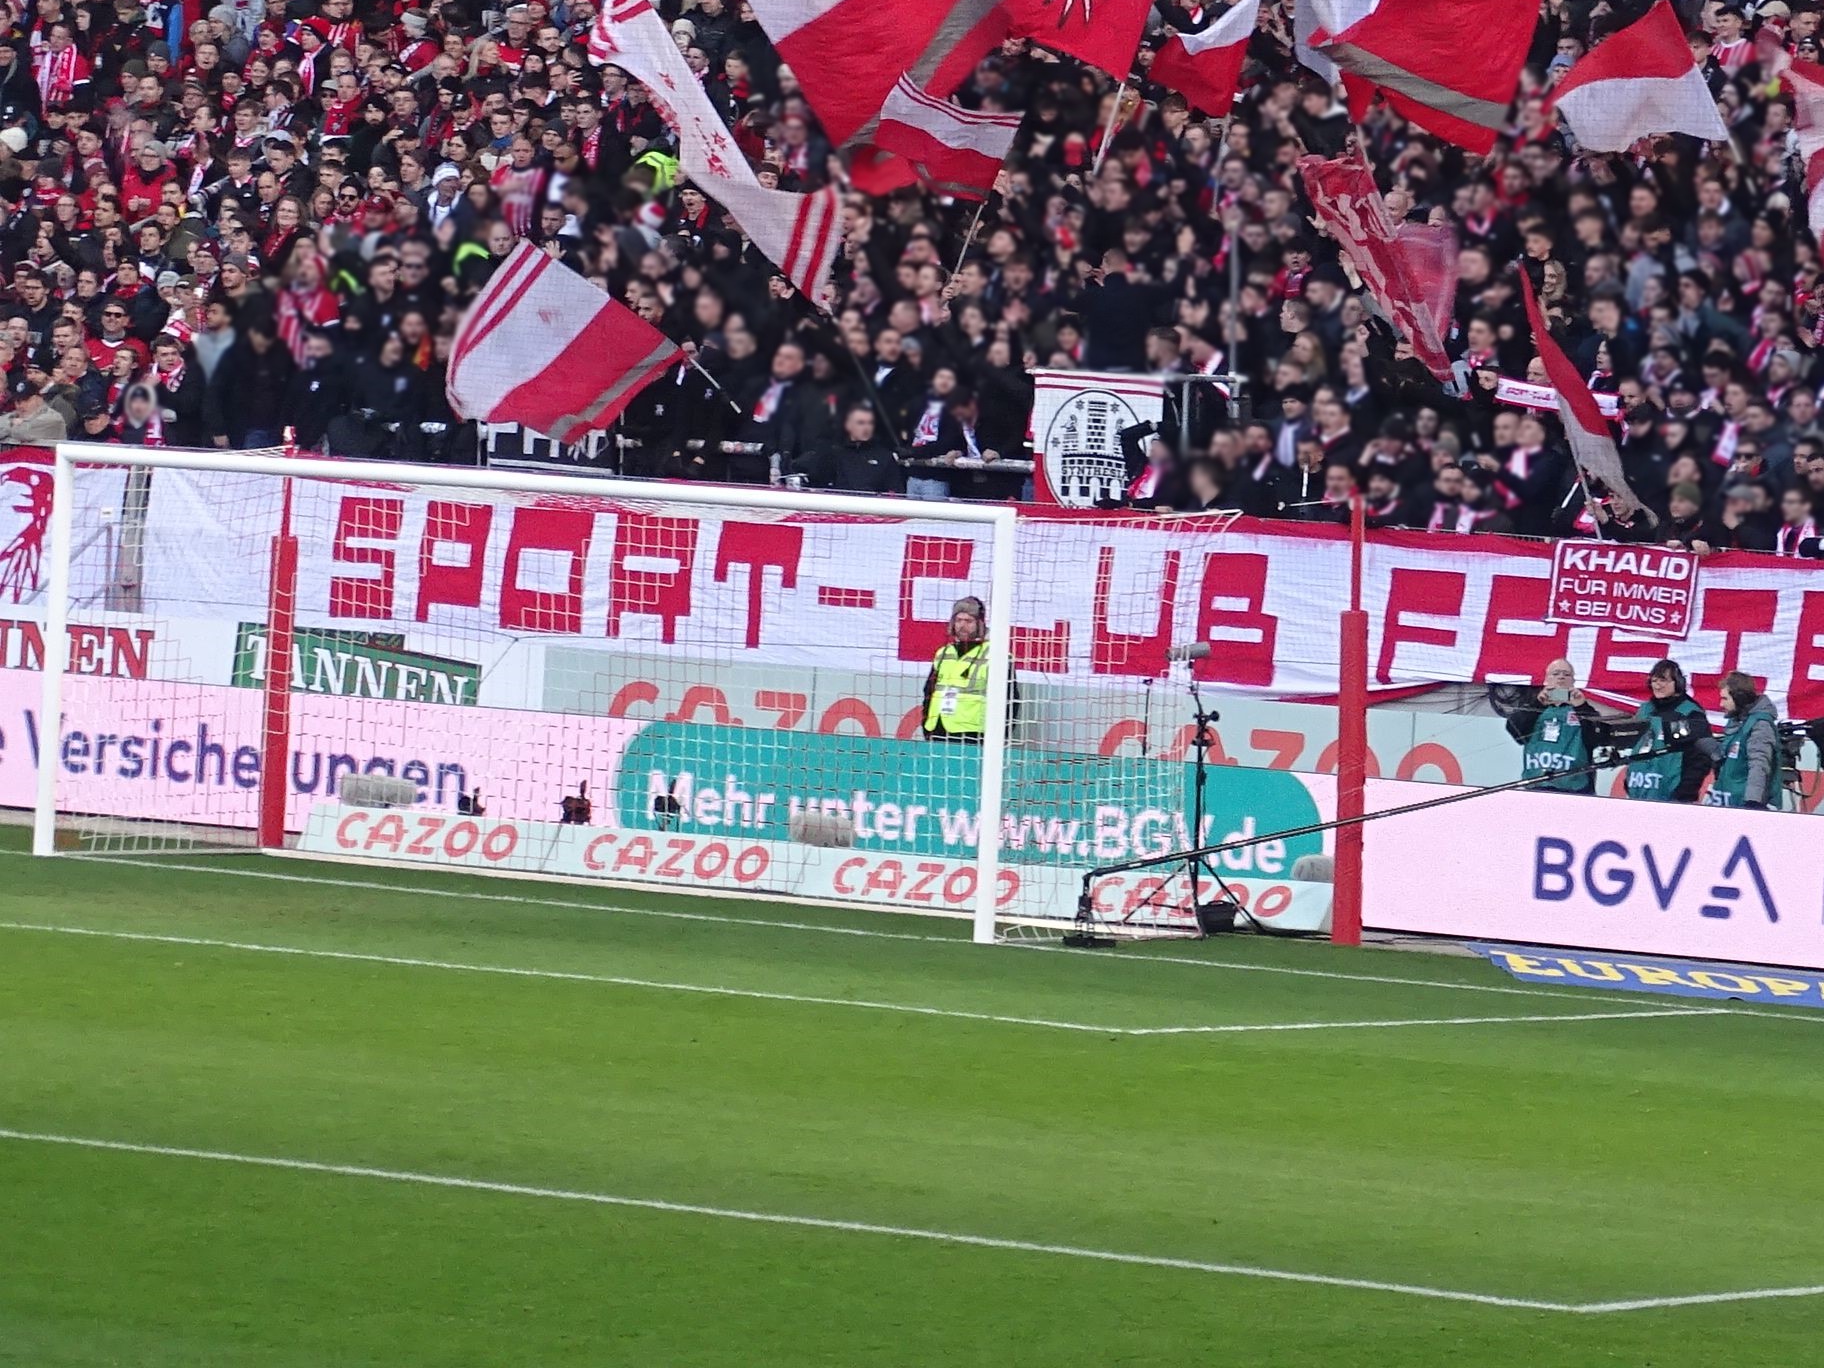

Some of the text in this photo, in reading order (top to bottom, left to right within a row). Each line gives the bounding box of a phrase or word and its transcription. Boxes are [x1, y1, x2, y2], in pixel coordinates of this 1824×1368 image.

[1563, 547, 1690, 580] KHALID
[1559, 574, 1687, 606] FÜR IMMER
[1575, 599, 1666, 624] BEI UNS
[1525, 752, 1576, 771] HOST
[646, 769, 775, 830] Mehr
[336, 811, 518, 862] CAZOO
[584, 833, 771, 883] CAZOO
[833, 856, 1020, 908] CAZOO
